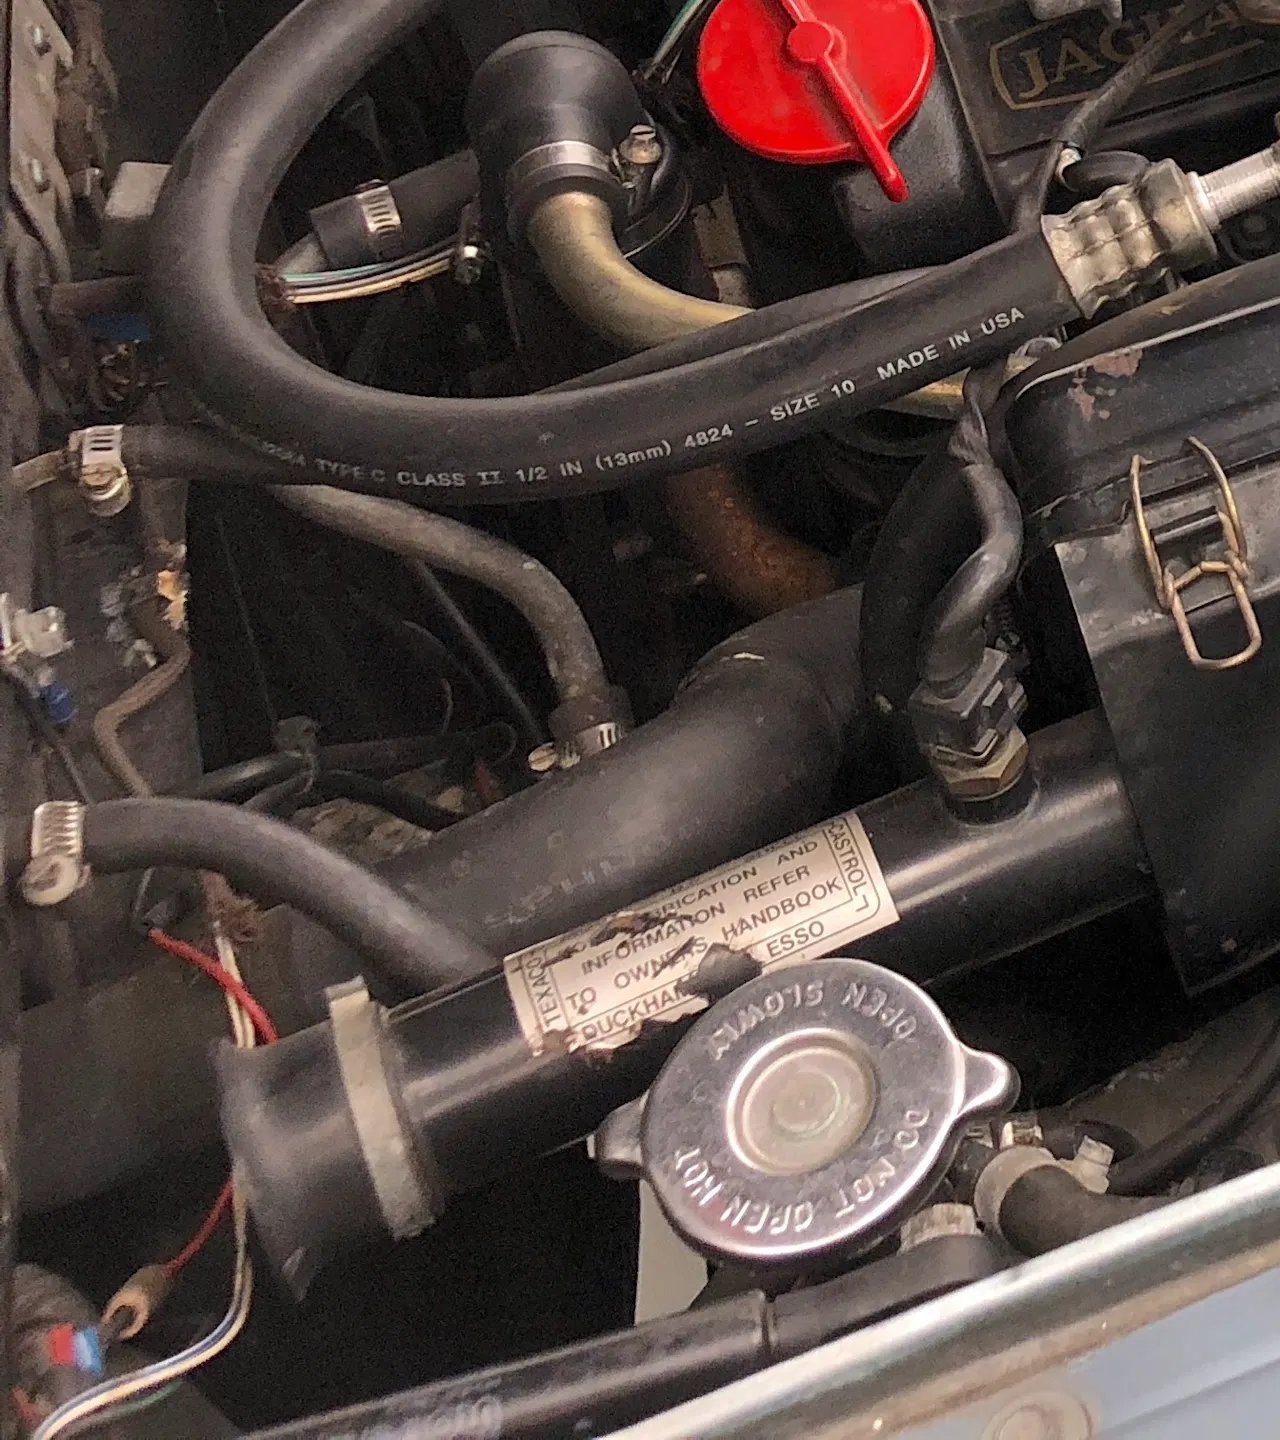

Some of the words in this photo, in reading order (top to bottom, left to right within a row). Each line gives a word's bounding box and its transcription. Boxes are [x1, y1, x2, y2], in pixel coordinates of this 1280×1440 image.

[316, 458, 366, 482] TYPE
[396, 469, 466, 487] CLASS
[515, 465, 547, 484] 1/2
[559, 460, 583, 478] IN
[594, 439, 674, 473] (13mm)
[682, 423, 734, 451] 4824
[769, 392, 821, 424] SIZE
[829, 378, 857, 401] 10
[875, 343, 940, 381] MADE
[947, 329, 972, 351] IN
[979, 306, 1026, 337] USA
[776, 840, 819, 867] AND
[828, 823, 868, 898] CASTROL
[565, 986, 598, 1011] TO
[720, 876, 844, 942] HANDBOOK
[580, 900, 725, 976] INFORMATION
[742, 864, 811, 903] REFER
[765, 920, 826, 958] ESSO
[526, 953, 563, 1028] TEXACO
[840, 981, 918, 1040] OPEN
[894, 1108, 931, 1150] DO
[673, 1144, 723, 1207] HOT
[834, 1155, 897, 1219] NOT
[719, 1198, 815, 1236] OPEN
